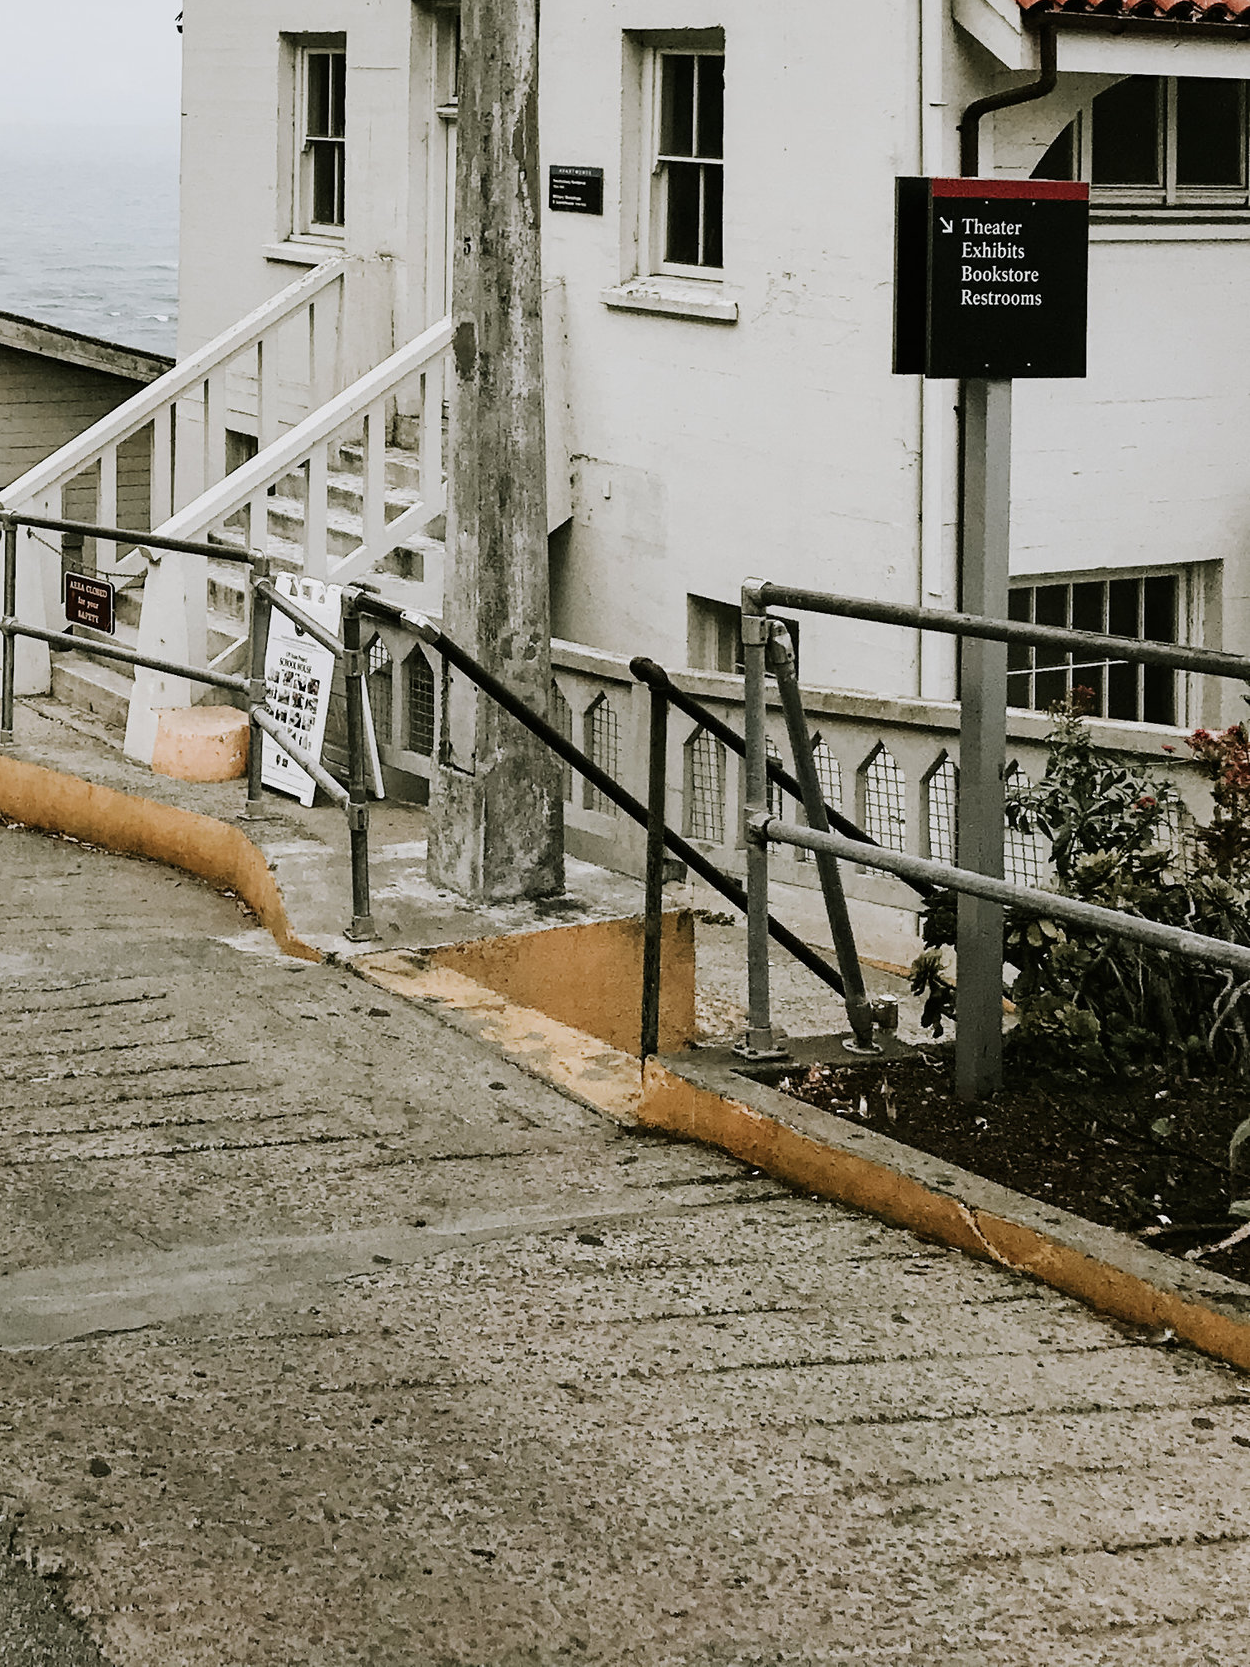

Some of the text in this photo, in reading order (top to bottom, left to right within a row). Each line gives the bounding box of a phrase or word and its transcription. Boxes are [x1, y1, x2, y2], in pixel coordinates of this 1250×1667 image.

[961, 218, 1022, 235] Theater
[463, 236, 471, 255] 5
[961, 241, 1025, 259] Exhibits
[961, 265, 1039, 282] Bookstore
[960, 289, 1042, 306] Restrooms
[70, 581, 107, 598] AREA CLOSED
[87, 600, 99, 609] your
[78, 610, 99, 623] SAFETY
